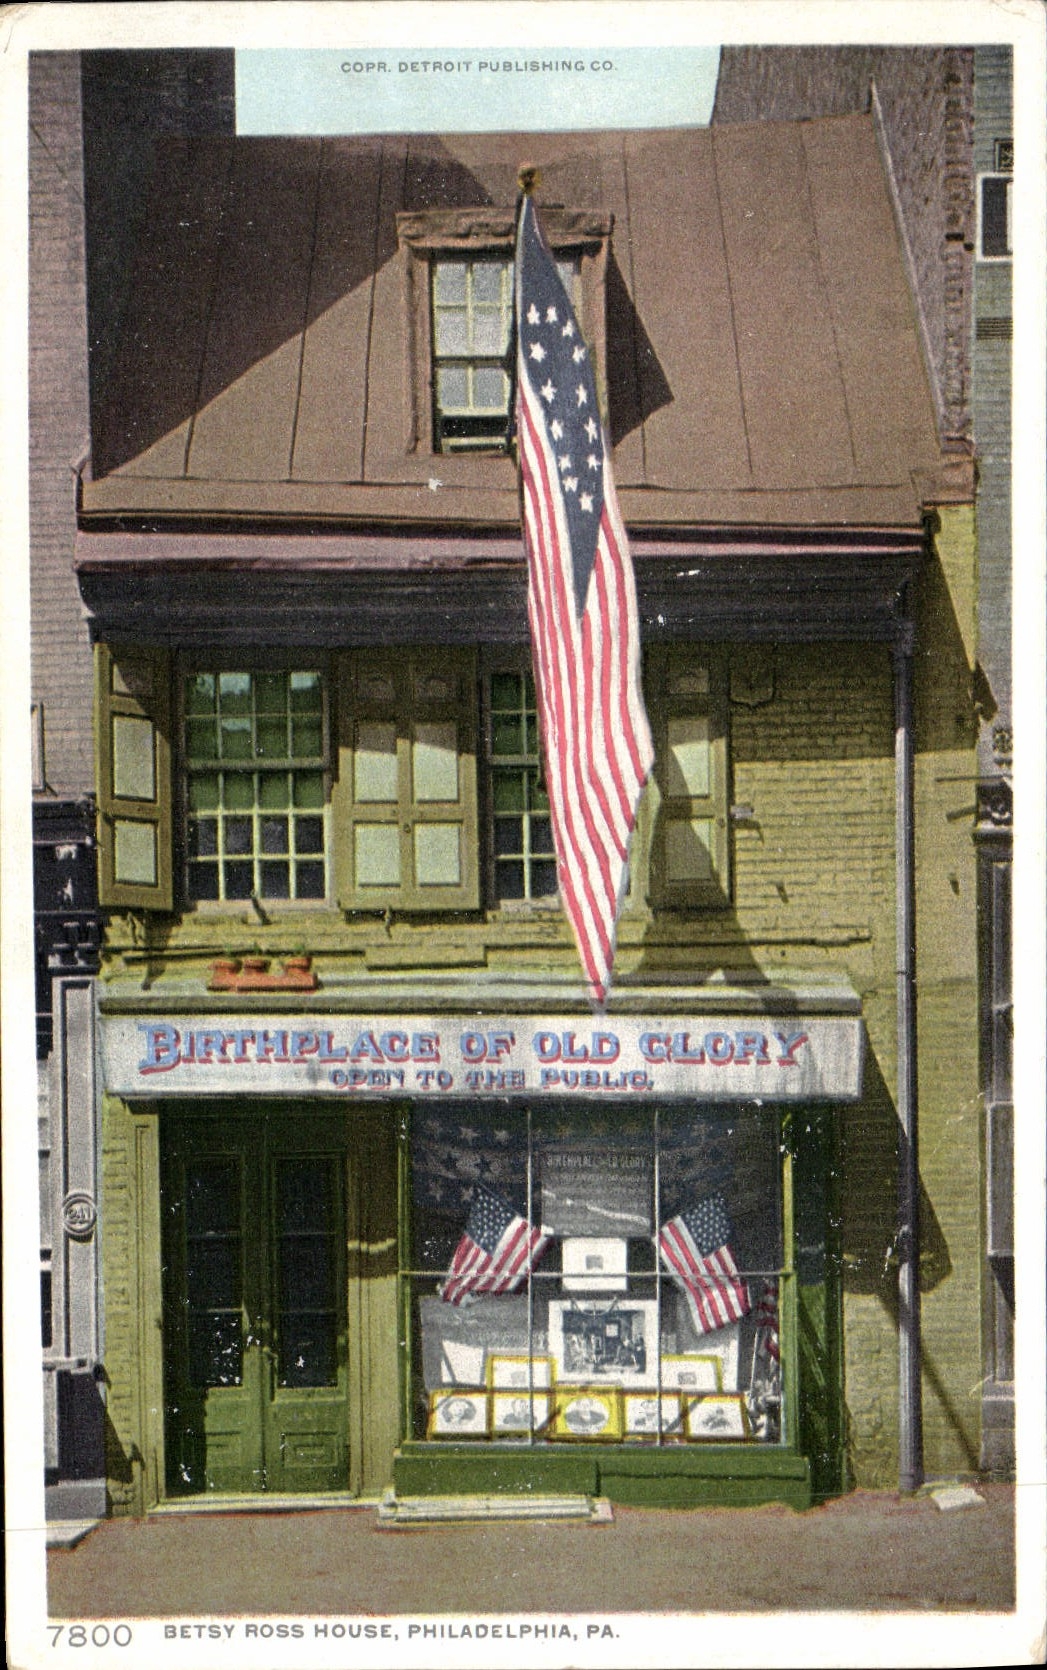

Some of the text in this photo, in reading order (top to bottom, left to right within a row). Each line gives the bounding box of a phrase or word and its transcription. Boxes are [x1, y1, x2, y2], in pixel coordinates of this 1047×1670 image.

[138, 1024, 807, 1075] BIRTHPLACE OF OLD GLORY
[328, 1069, 405, 1090] OPEN
[417, 1070, 453, 1090] TO
[465, 1069, 525, 1090] THE
